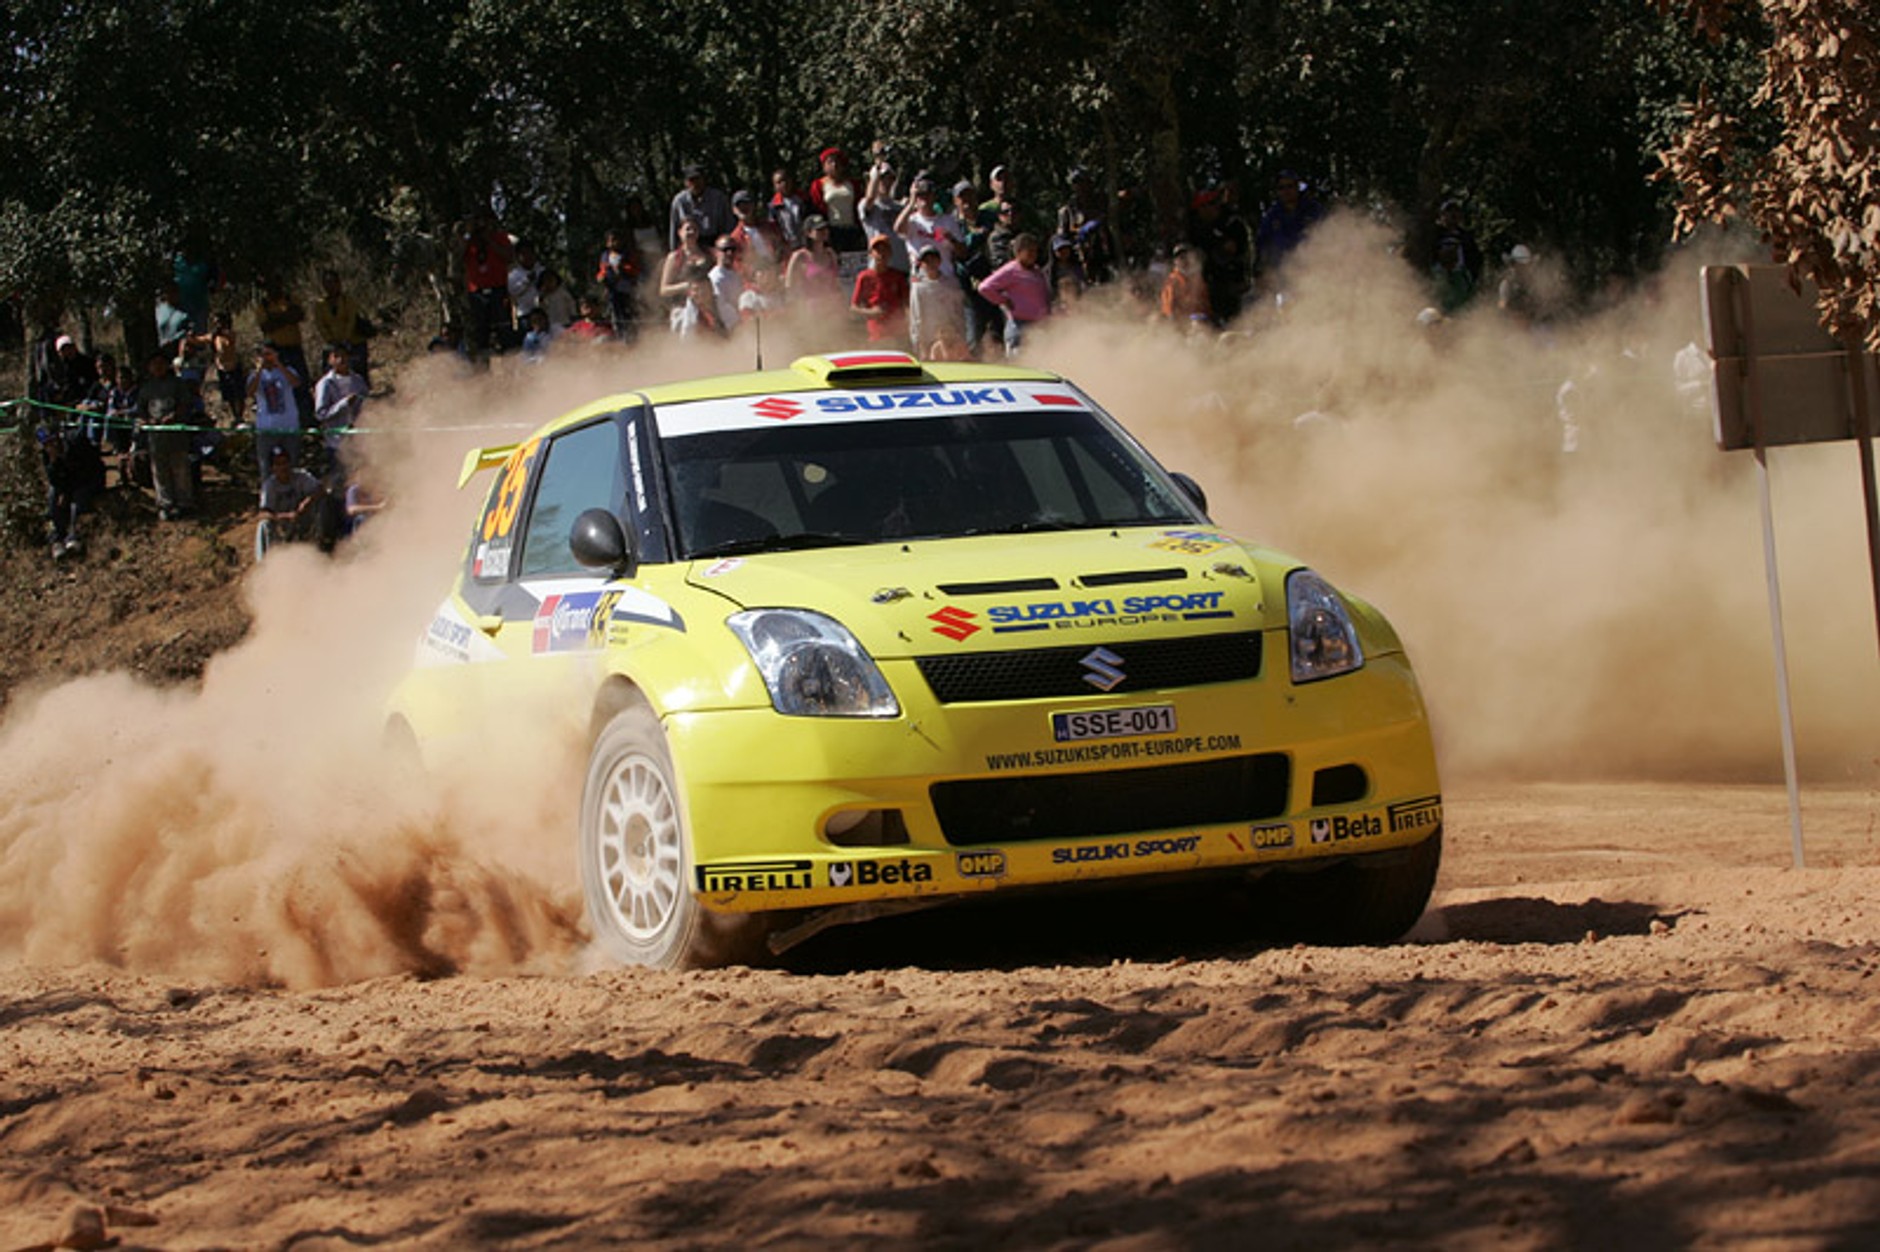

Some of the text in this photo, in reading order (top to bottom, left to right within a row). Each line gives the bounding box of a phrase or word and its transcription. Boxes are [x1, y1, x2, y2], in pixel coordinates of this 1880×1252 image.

[816, 387, 1017, 413] SUZUKI
[986, 591, 1225, 624] SUZUKI SPORT
[1055, 613, 1179, 629] EUROPE
[1071, 709, 1172, 737] SSE-001
[986, 735, 1241, 771] WWW.SUZUKISPORT-EUROPE.COM
[1253, 827, 1292, 849] OMP
[1332, 814, 1381, 841] Beta
[1052, 836, 1201, 864] SUZUKI SPORT
[694, 859, 812, 892] PIRELLI
[856, 860, 932, 885] Beta
[960, 854, 1002, 875] OMP
